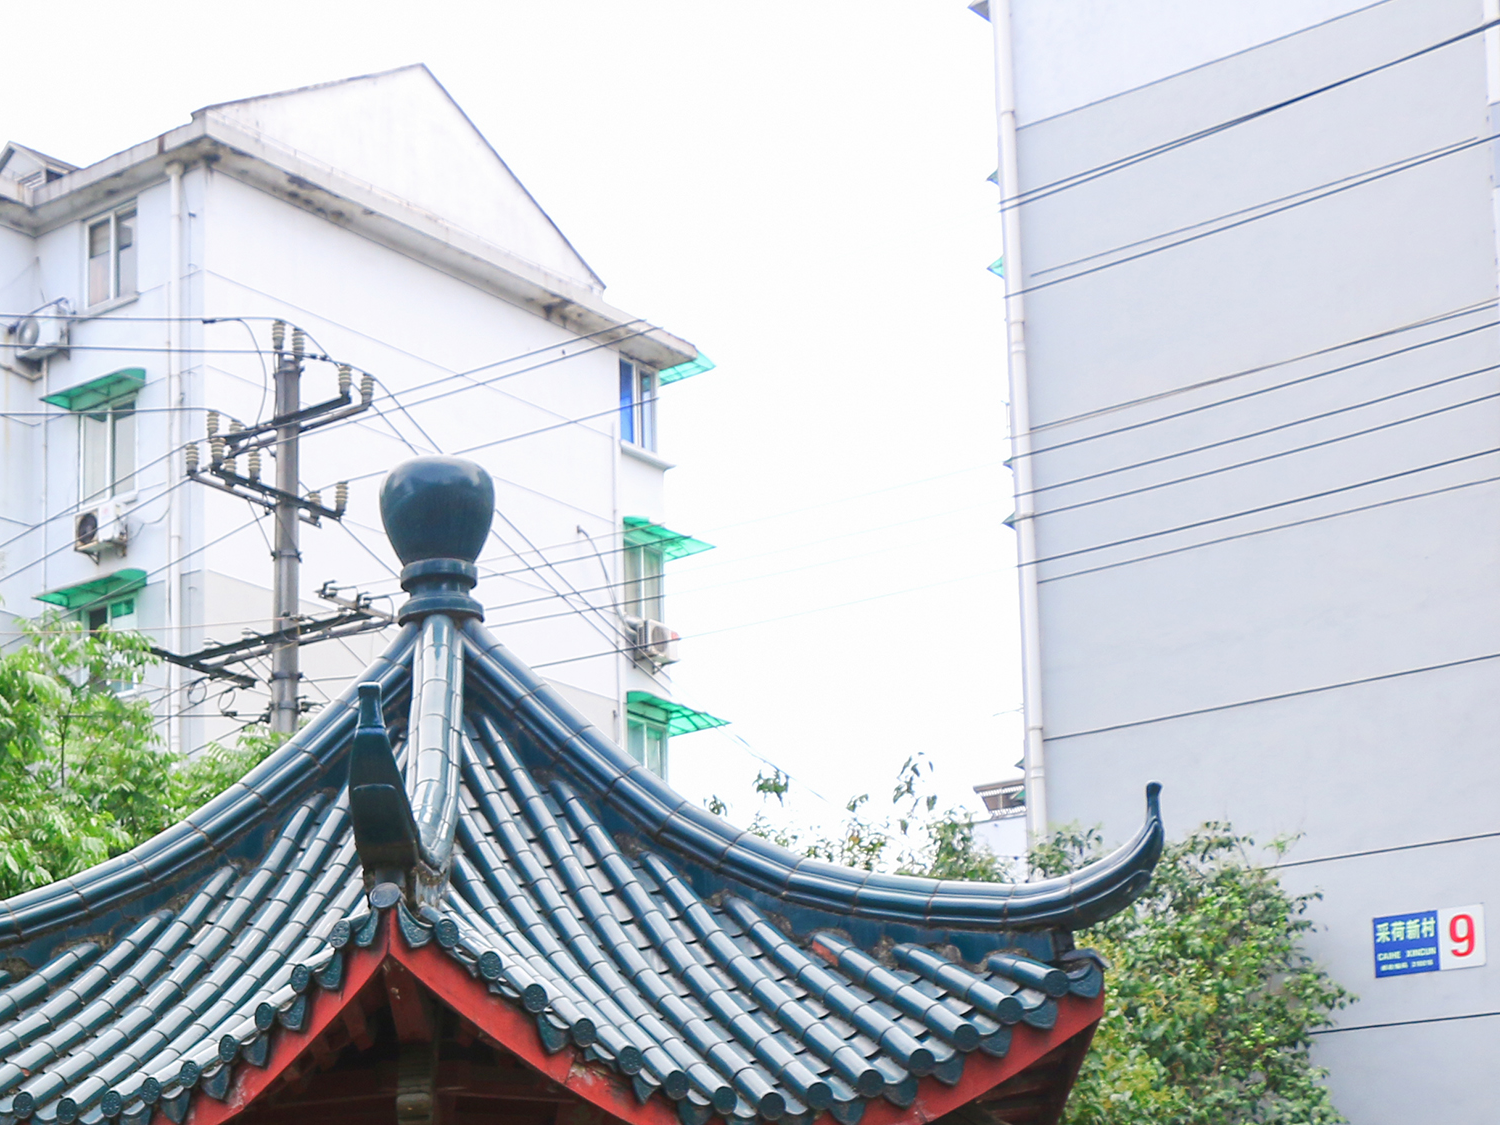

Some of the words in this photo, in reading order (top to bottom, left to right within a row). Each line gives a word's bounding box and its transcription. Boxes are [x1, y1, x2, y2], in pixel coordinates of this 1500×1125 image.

[1376, 917, 1436, 943] 采荷新村
[1449, 913, 1475, 958] 9
[1406, 947, 1437, 958] XINCUN
